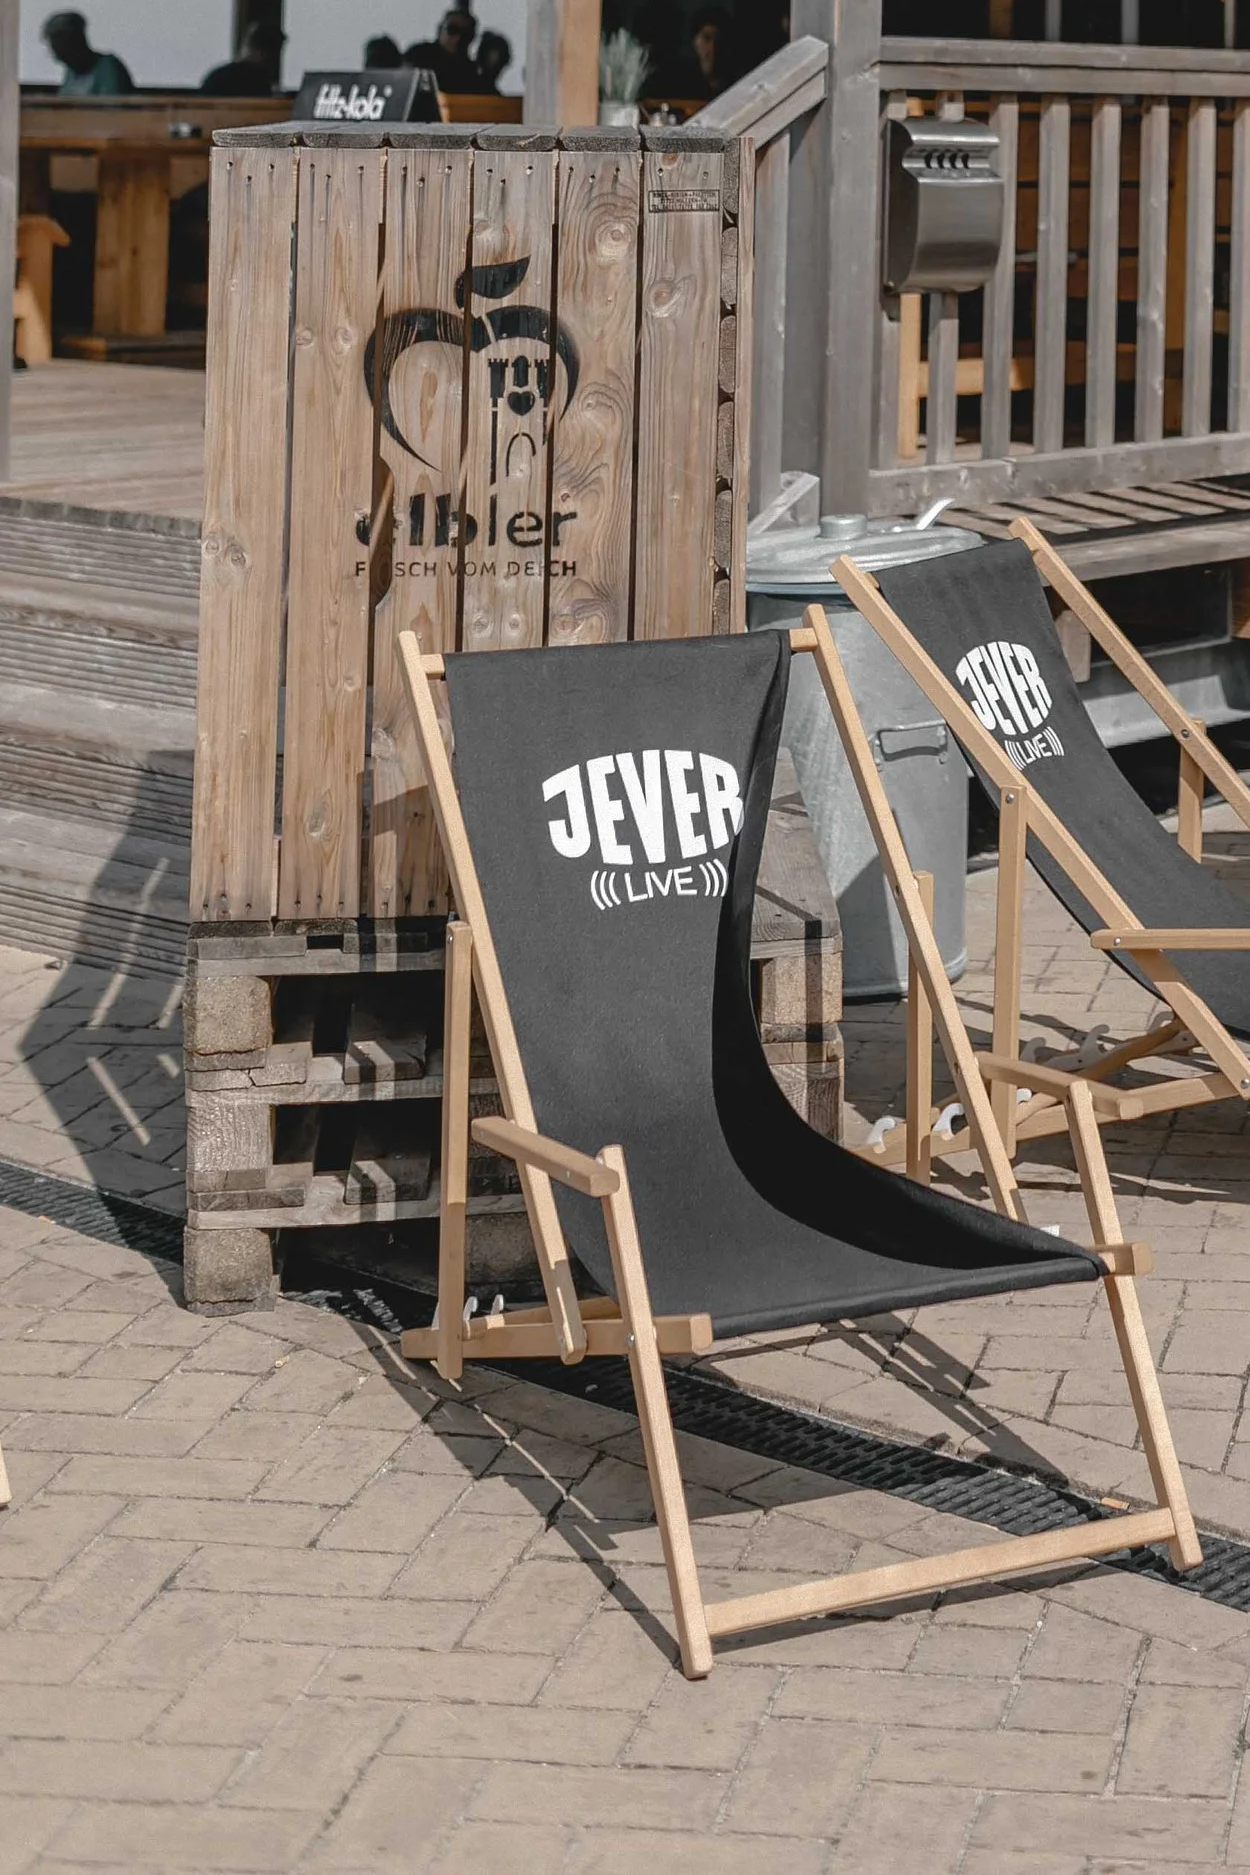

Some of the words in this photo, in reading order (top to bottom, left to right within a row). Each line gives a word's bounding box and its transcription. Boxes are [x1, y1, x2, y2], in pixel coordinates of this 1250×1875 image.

[356, 561, 437, 577] FSCH
[447, 561, 497, 577] VOM
[955, 640, 1053, 736] JEVER
[542, 749, 744, 865] JEVER
